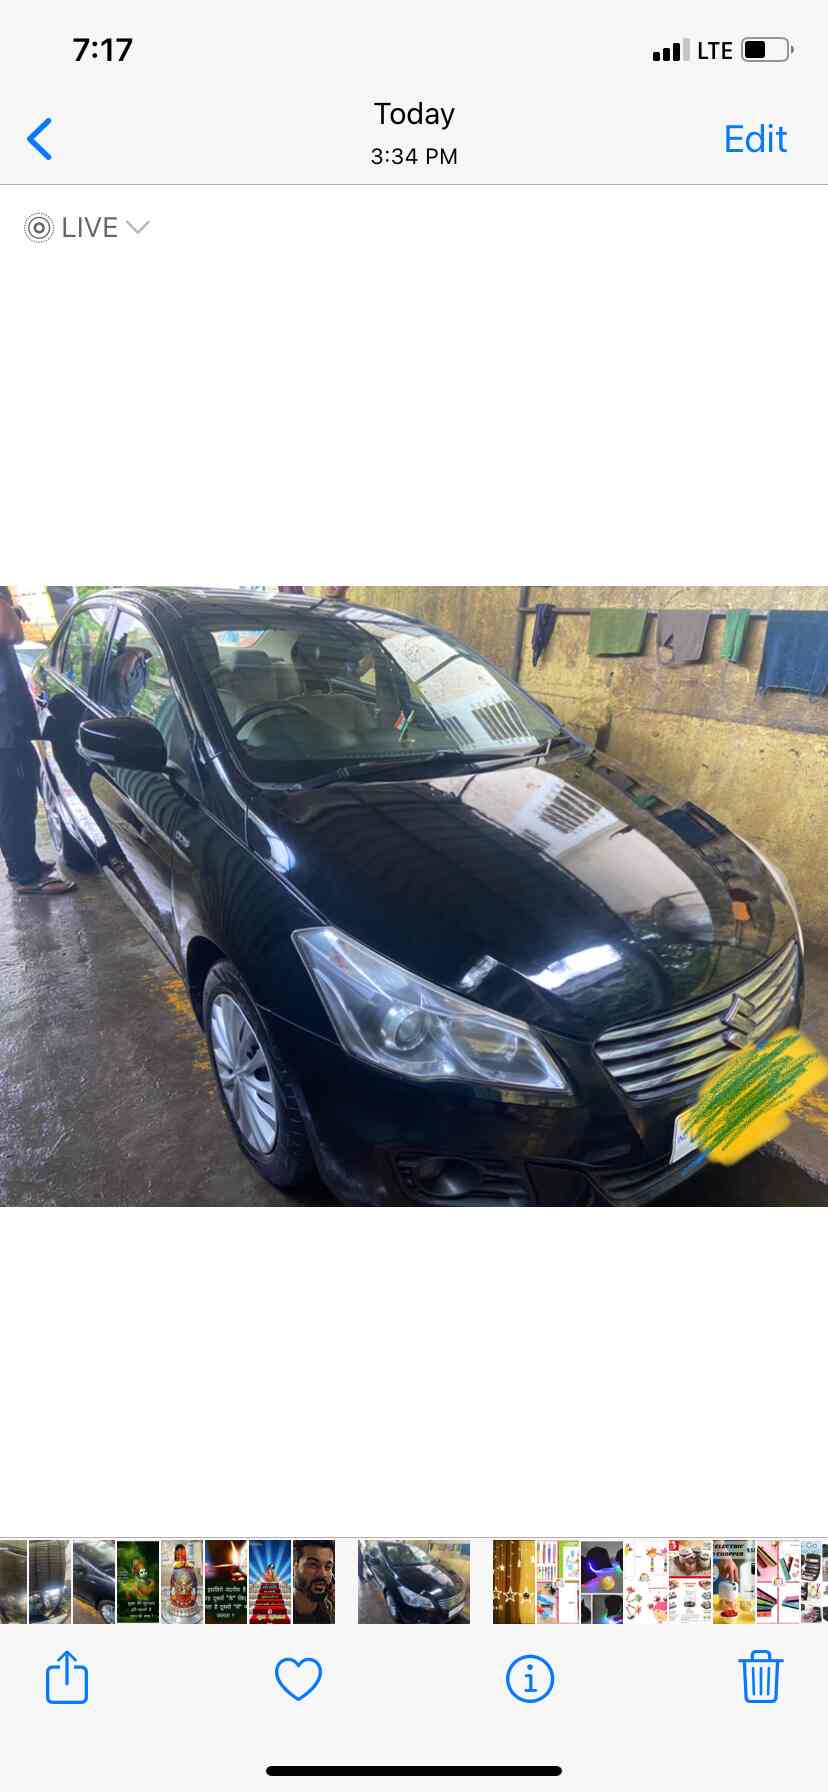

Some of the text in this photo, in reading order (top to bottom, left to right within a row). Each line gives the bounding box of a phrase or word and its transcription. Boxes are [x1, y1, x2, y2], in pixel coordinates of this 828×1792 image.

[73, 38, 133, 62] 7:17
[698, 42, 732, 59] LTE
[374, 102, 455, 130] Today
[723, 123, 788, 153] Edit
[371, 148, 458, 165] 3:34 PM
[62, 217, 118, 238] LIVE
